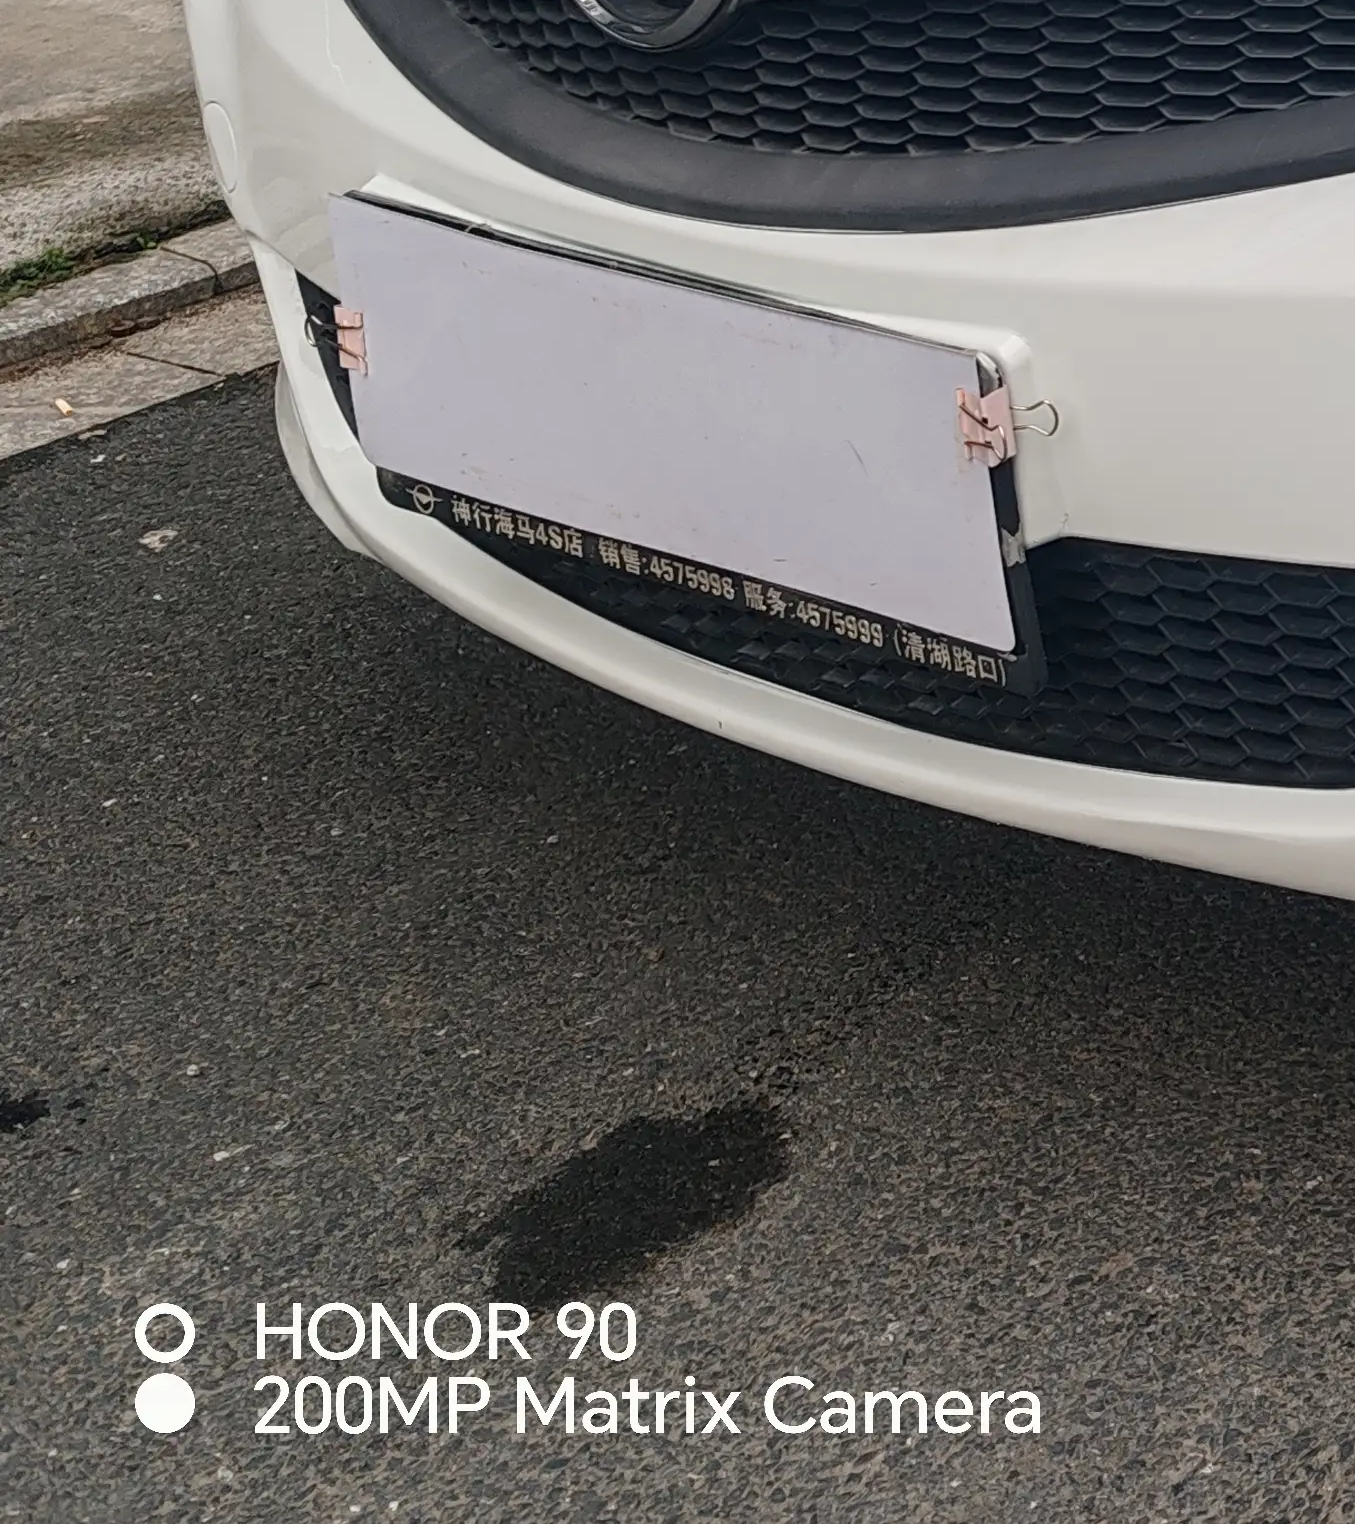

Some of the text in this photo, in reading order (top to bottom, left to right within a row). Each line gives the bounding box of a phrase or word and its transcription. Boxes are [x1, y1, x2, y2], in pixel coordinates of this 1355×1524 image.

[451, 495, 583, 558] 神行海马4S店
